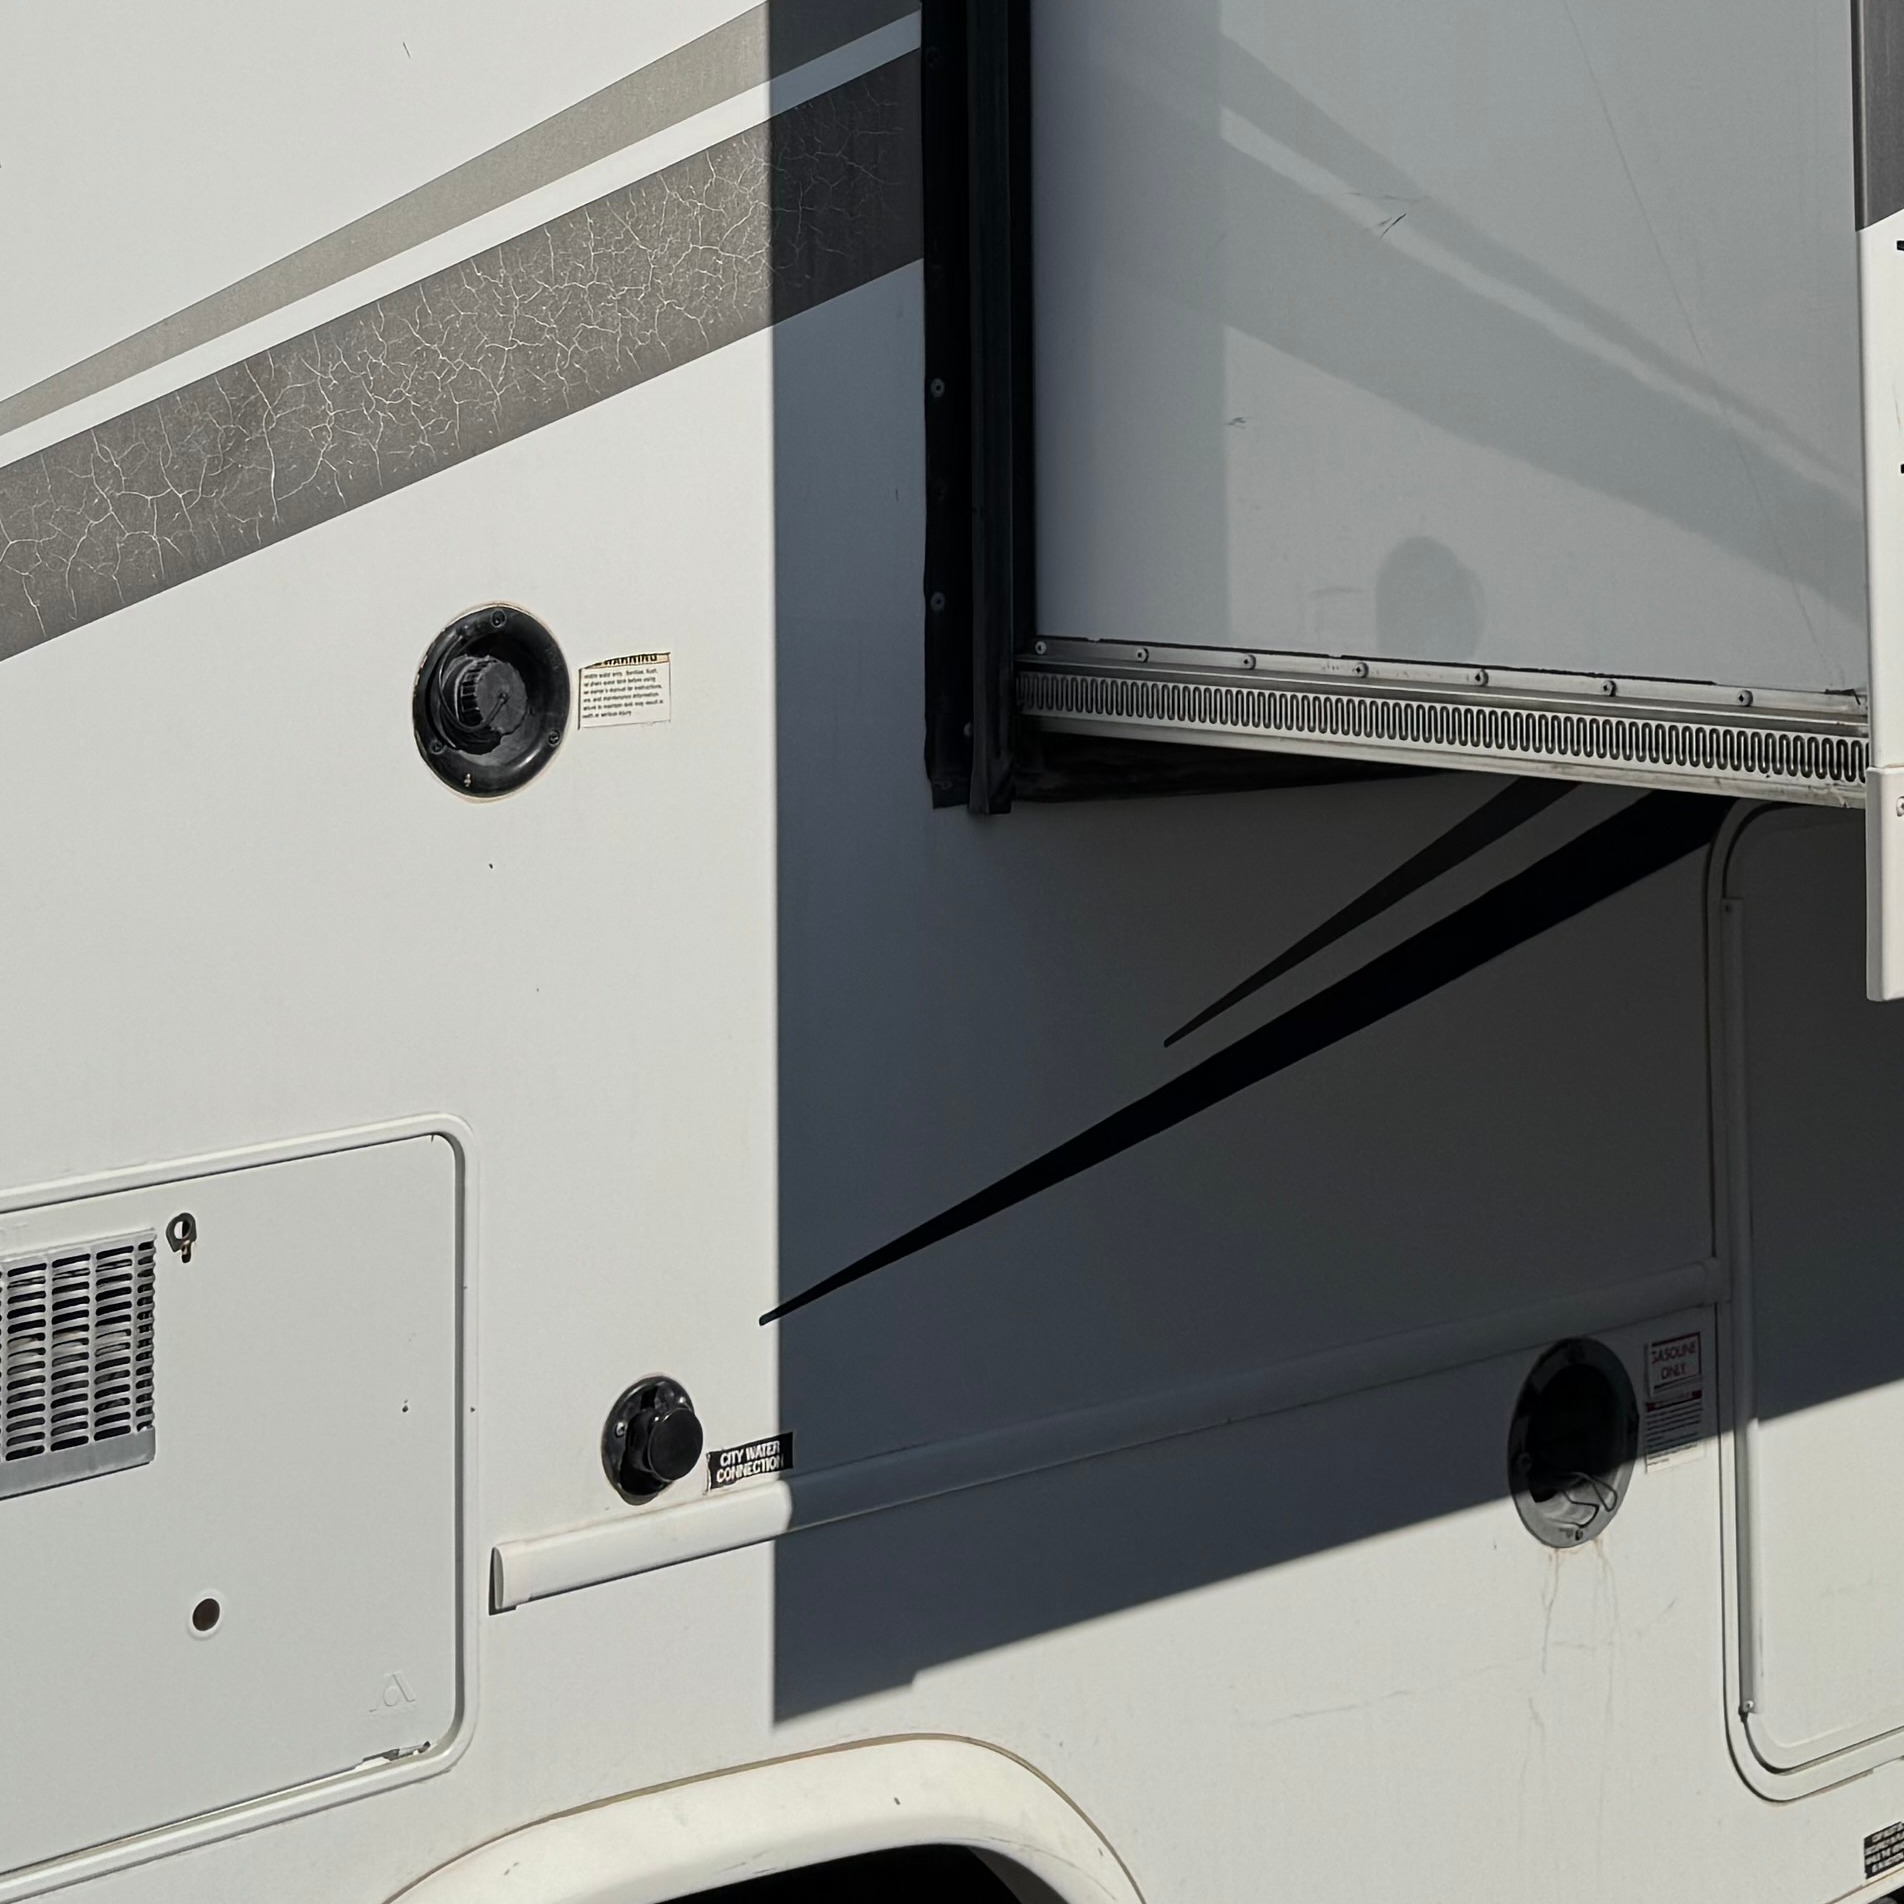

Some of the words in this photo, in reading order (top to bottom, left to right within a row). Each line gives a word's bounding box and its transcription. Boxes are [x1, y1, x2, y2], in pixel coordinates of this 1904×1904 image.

[720, 1448, 744, 1467] CITY
[745, 1440, 780, 1461] WATER
[716, 1454, 785, 1483] CONNECTION
